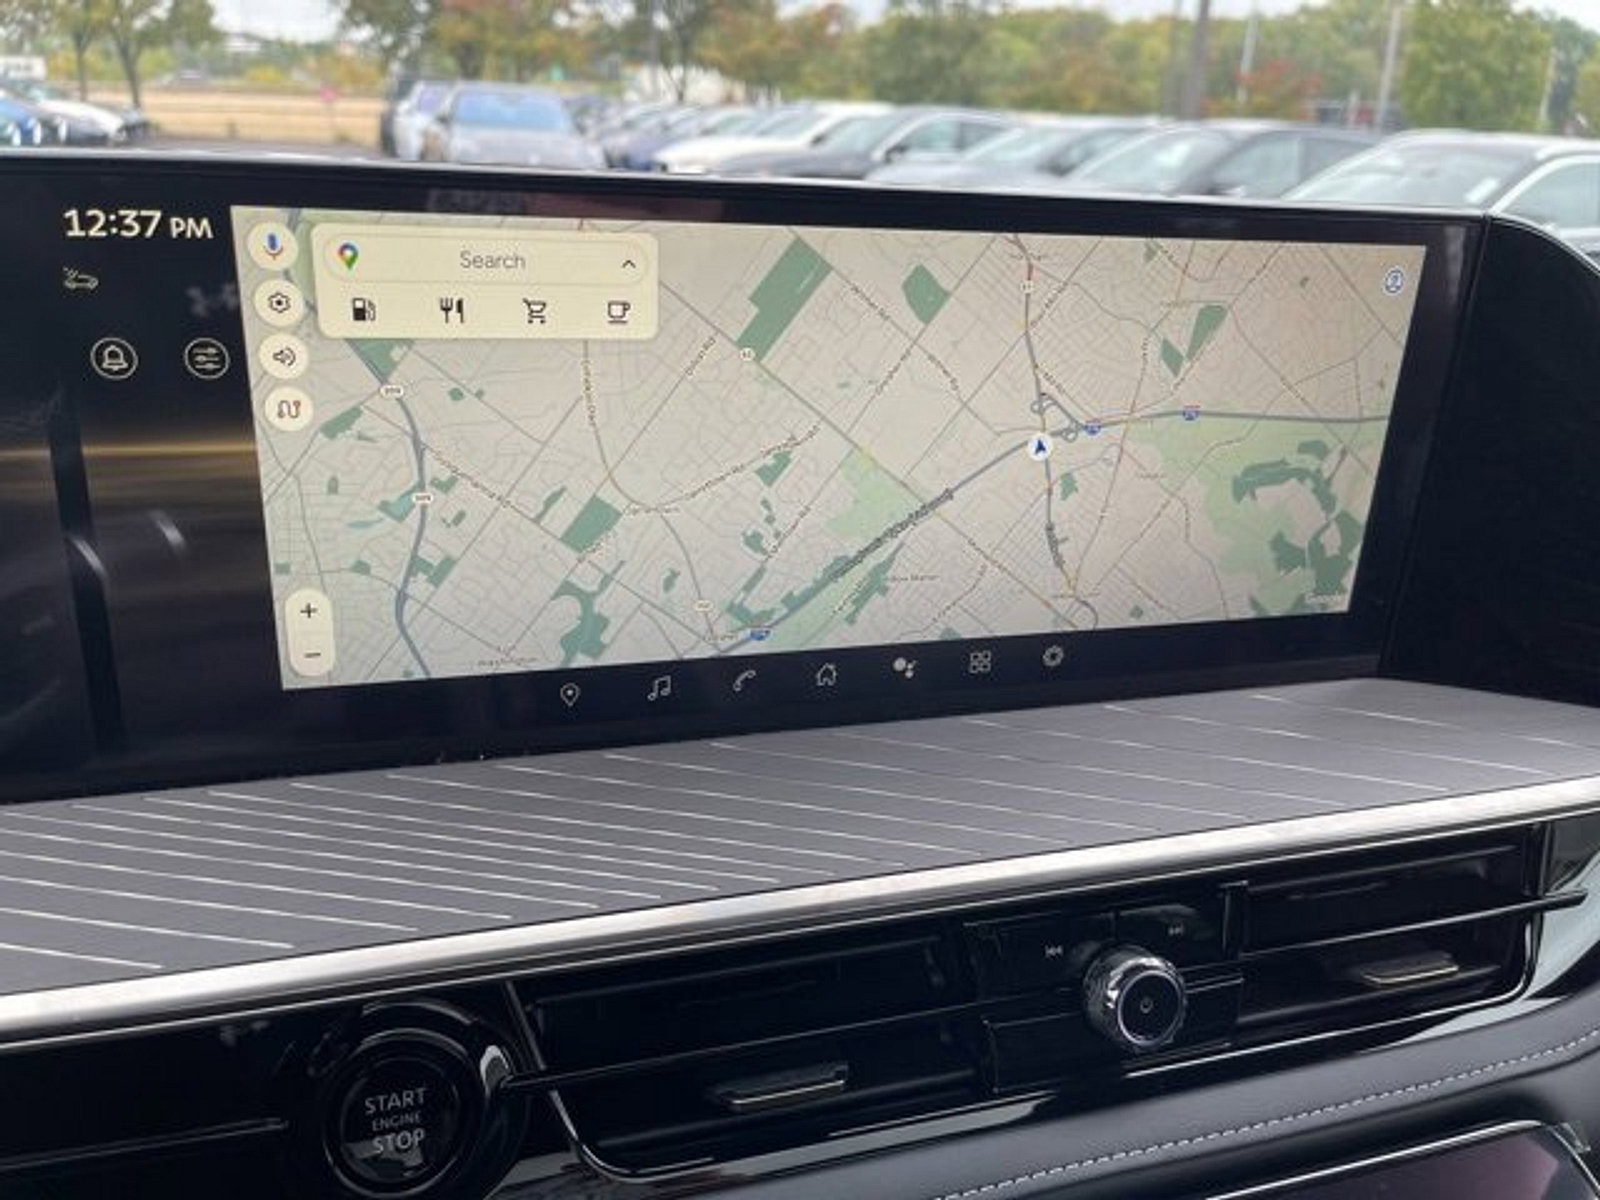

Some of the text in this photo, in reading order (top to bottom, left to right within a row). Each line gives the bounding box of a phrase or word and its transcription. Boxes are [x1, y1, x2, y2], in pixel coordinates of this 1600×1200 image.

[63, 207, 214, 239] 12:37 PM
[459, 249, 527, 269] Search
[365, 1087, 426, 1115] START
[372, 1110, 421, 1131] ENGINE
[372, 1128, 425, 1154] STOP
